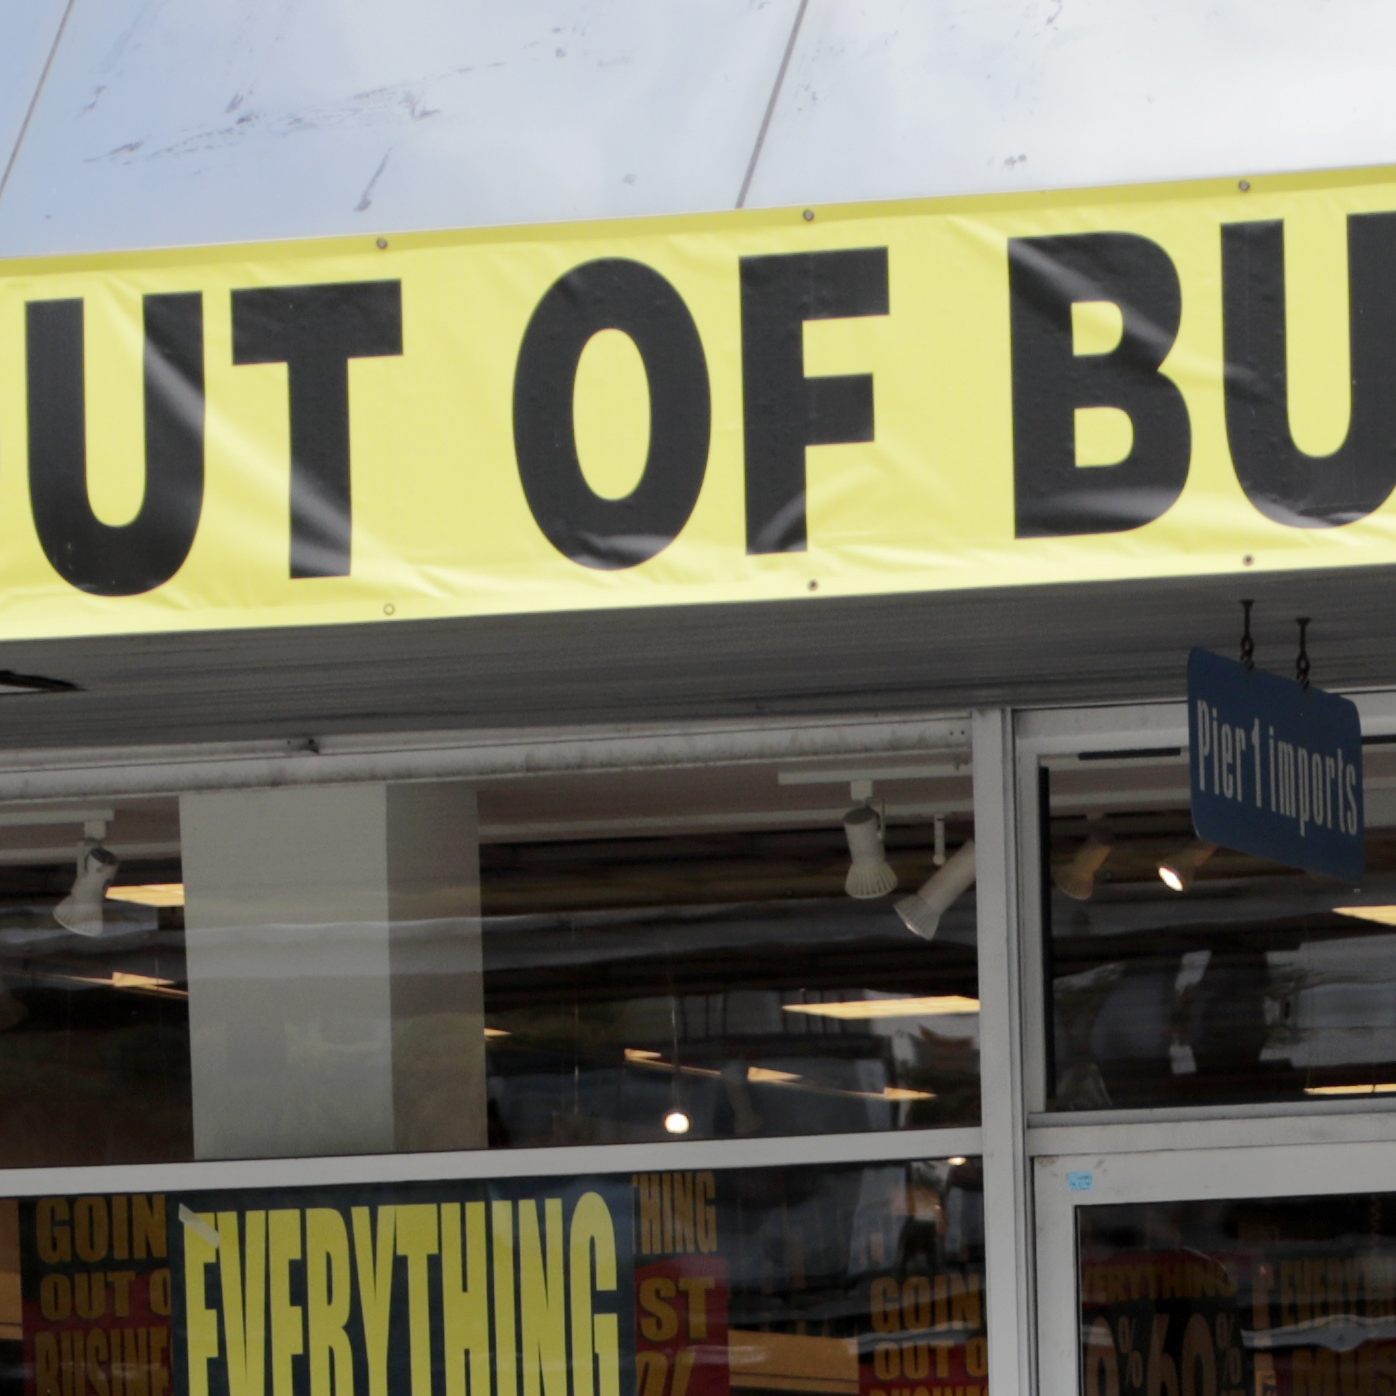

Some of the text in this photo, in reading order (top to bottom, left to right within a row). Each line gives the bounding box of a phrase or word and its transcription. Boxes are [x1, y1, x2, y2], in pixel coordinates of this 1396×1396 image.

[513, 245, 890, 570] OF
[1197, 699, 1246, 803] Pier
[1269, 726, 1358, 837] imports
[36, 1194, 168, 1265] GOIN
[40, 1271, 136, 1321] OUT
[639, 1276, 716, 1343] ST
[870, 1273, 981, 1334] GOIN
[874, 1339, 956, 1382] OUT
